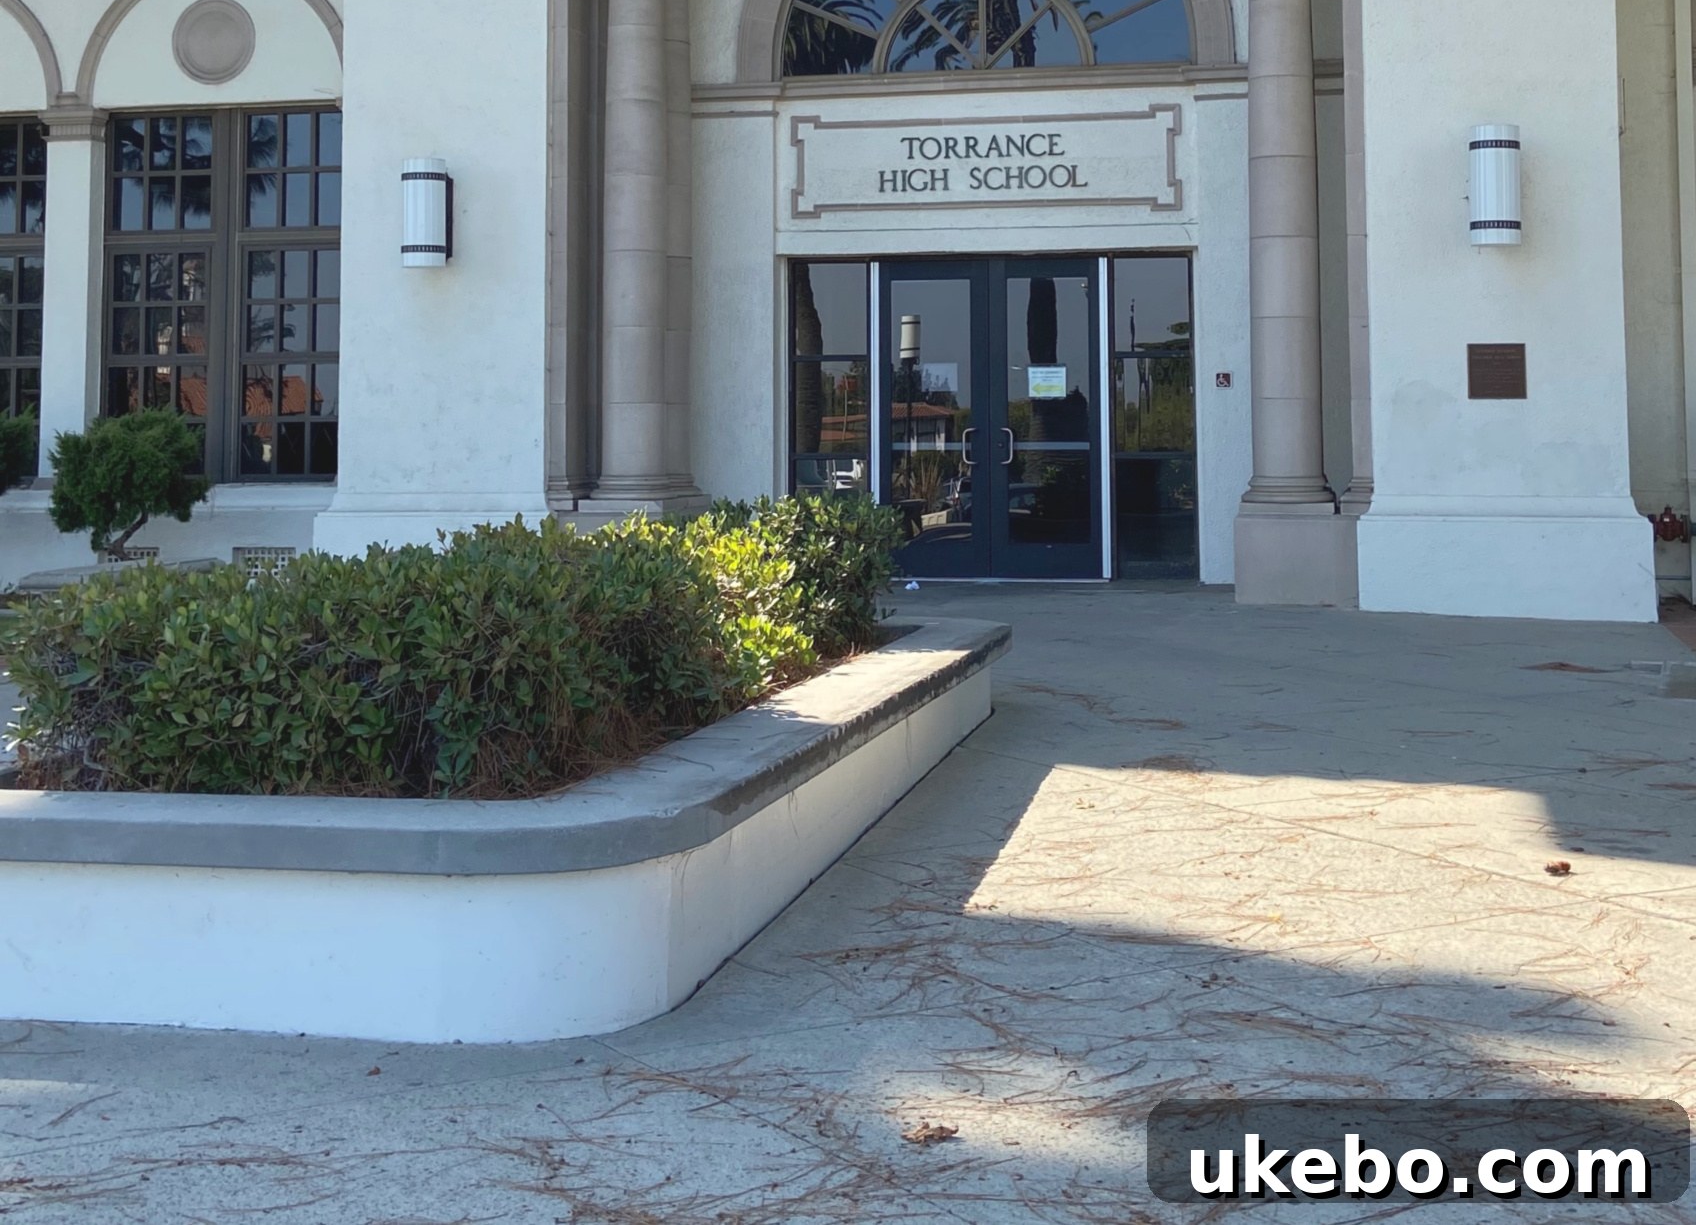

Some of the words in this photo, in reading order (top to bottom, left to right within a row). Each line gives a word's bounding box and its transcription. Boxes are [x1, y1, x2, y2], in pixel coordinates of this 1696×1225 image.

[899, 133, 1065, 160] TORRANCE
[878, 168, 949, 193] HIGH
[969, 164, 1088, 190] SCHOOL
